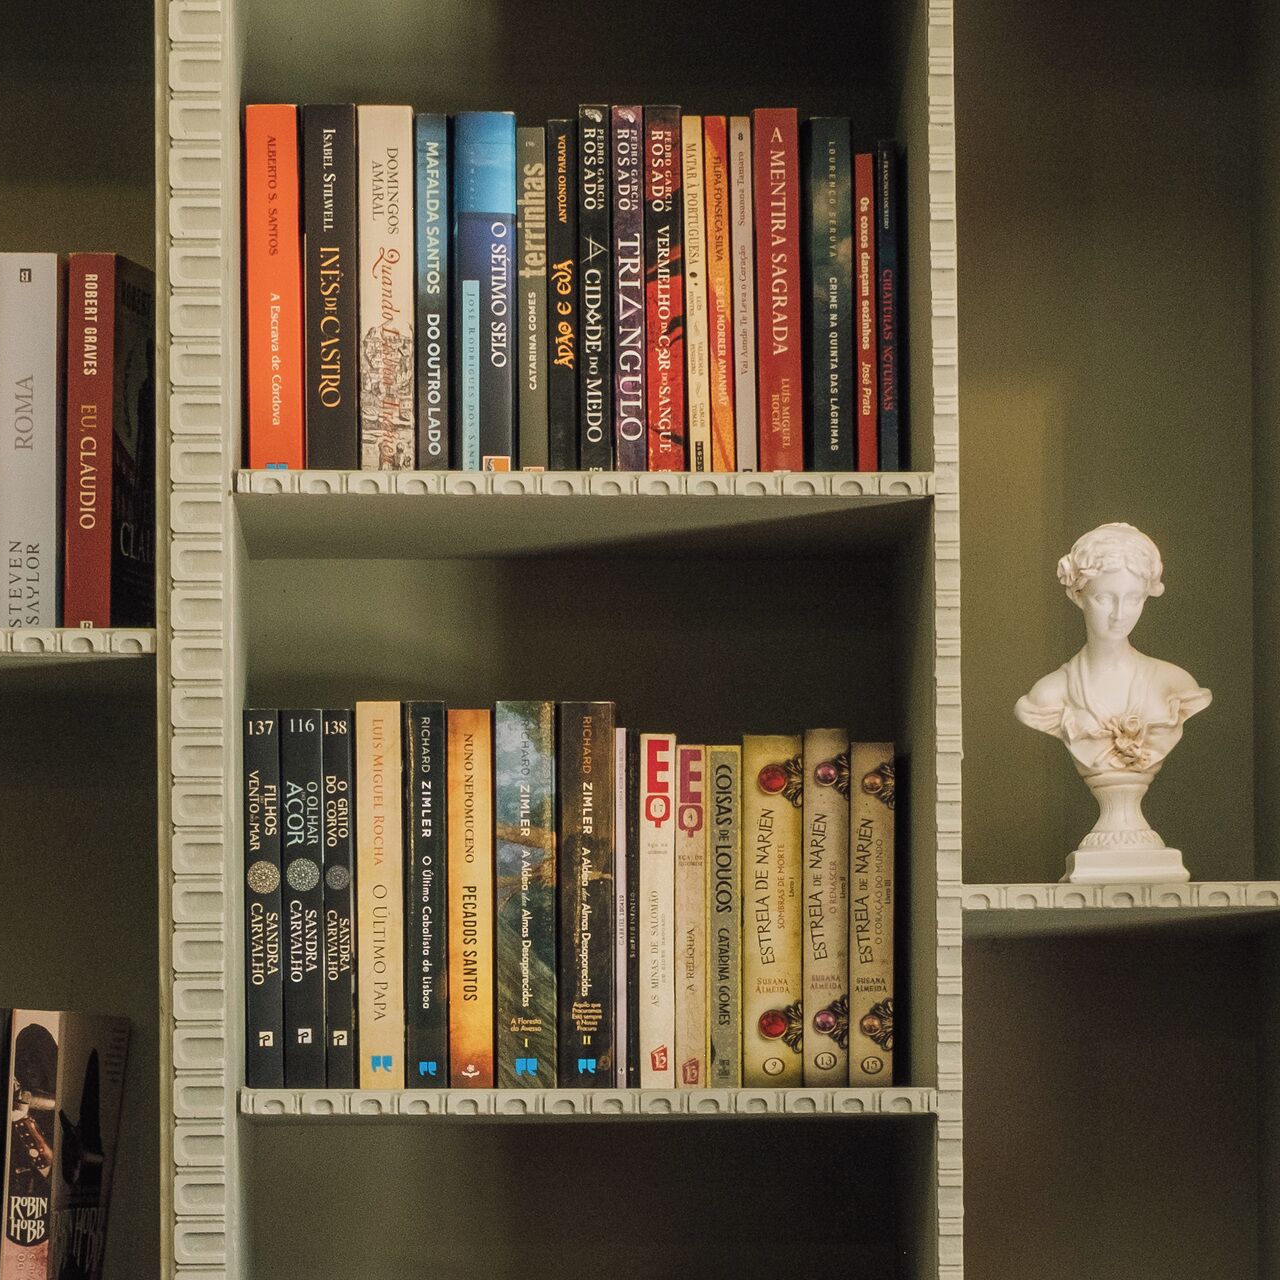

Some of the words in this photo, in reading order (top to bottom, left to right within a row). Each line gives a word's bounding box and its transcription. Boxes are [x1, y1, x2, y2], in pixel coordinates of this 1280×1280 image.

[771, 128, 784, 142] A
[371, 161, 384, 220] AMARAL
[386, 146, 399, 235] DOMINGOS
[426, 141, 439, 220] MAFALDA
[770, 150, 787, 245] MENTIRA
[490, 222, 506, 238] O
[320, 247, 344, 296] INÊS
[426, 224, 440, 294] SANTOS
[490, 243, 509, 317] SÉTIMO
[85, 274, 97, 322] ROBERT
[270, 293, 280, 302] A
[325, 298, 335, 313] DE
[528, 292, 536, 329] GOMES
[771, 253, 788, 357] SAGRADA
[83, 327, 97, 376] GRAVES
[270, 305, 280, 352] Escrava
[427, 314, 439, 337] DO
[490, 321, 506, 367] SELO
[270, 356, 280, 371] de
[320, 316, 341, 409] CASTRO
[427, 343, 440, 402] OUTRO
[528, 331, 537, 390] CATARINA
[13, 374, 34, 452] ROMA
[81, 405, 97, 432] EU,
[271, 374, 282, 427] Córdova
[427, 408, 441, 455] LADO
[79, 436, 97, 530] CLÁUDIO
[248, 720, 273, 736] 137
[289, 718, 314, 733] 116
[324, 721, 347, 735] 138
[464, 733, 473, 766] NUNO
[464, 772, 473, 863] NEPOMUCENO
[715, 764, 732, 826] COISAS
[719, 830, 729, 841] DE
[373, 885, 387, 899] O
[715, 844, 732, 914] LOUCOS
[289, 900, 304, 983] CARVALHO
[305, 910, 317, 972] SANDRA
[372, 907, 388, 974] ÚLTIMO
[462, 886, 477, 945] PECADOS
[251, 903, 265, 986] CARVALHO
[266, 913, 279, 975] SANDRA
[374, 982, 387, 1021] PAPA
[463, 950, 477, 1002] SANTOS
